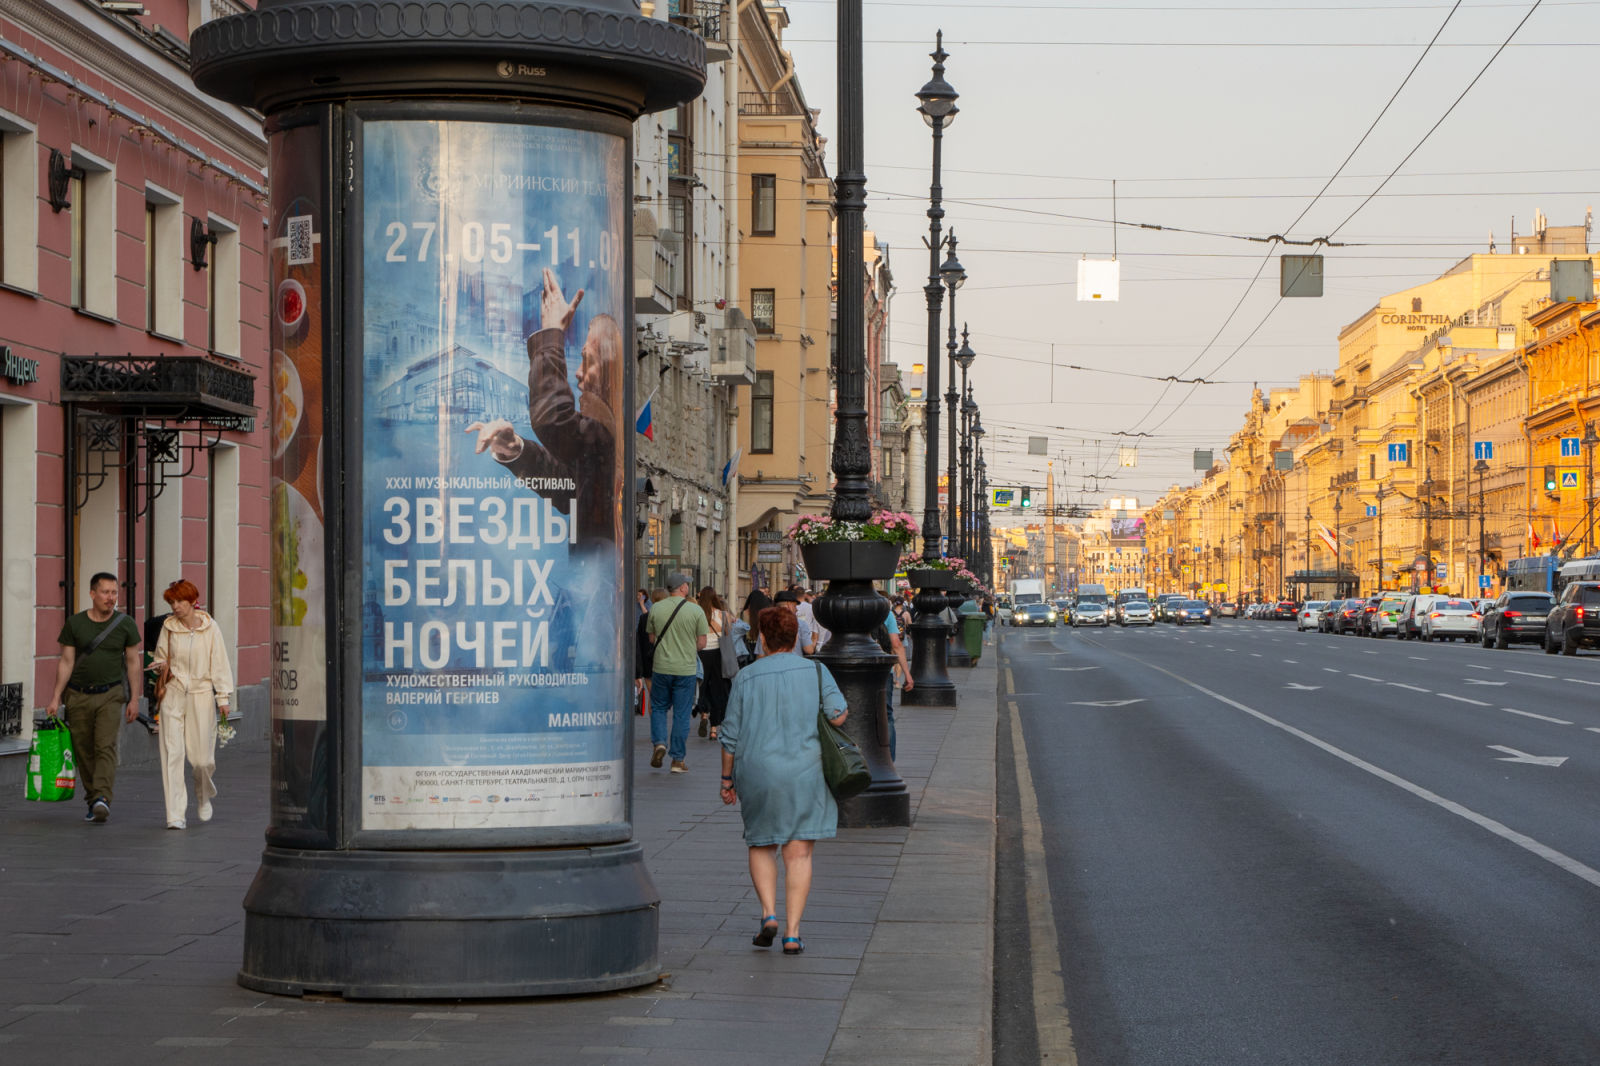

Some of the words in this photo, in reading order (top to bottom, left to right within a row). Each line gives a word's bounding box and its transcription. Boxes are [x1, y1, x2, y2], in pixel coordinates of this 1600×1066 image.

[518, 64, 546, 76] Russ
[473, 173, 579, 193] МАРИИНСКИЙ
[1381, 314, 1452, 324] CORINTHIA
[5, 346, 39, 386] Яндекс
[415, 474, 511, 490] МУЗЫКАЛЬНЫЙ
[514, 477, 576, 490] ФЕСТИВАЛЬ
[383, 496, 577, 550] ЗВЕЗДЫ
[384, 559, 555, 607] БЕЛЫХ
[384, 608, 549, 669] НОЧЕЙ
[386, 671, 505, 688] ХУДОЖЕСТВЕННЫЙ
[508, 673, 589, 687] РУКОВОДИТЕЛЬ
[386, 689, 442, 704] ВАЛЕРИЙ
[446, 691, 500, 704] ГЕРГИЕВ
[510, 767, 565, 777] АКАДЕМИЧЕСКИЙ
[565, 766, 598, 774] МАРИИНСКИЙ
[440, 778, 504, 786] САНКТ-ПЕТЕРБУРГ,
[505, 777, 548, 785] ТЕАТРАЛЬНАЯ
